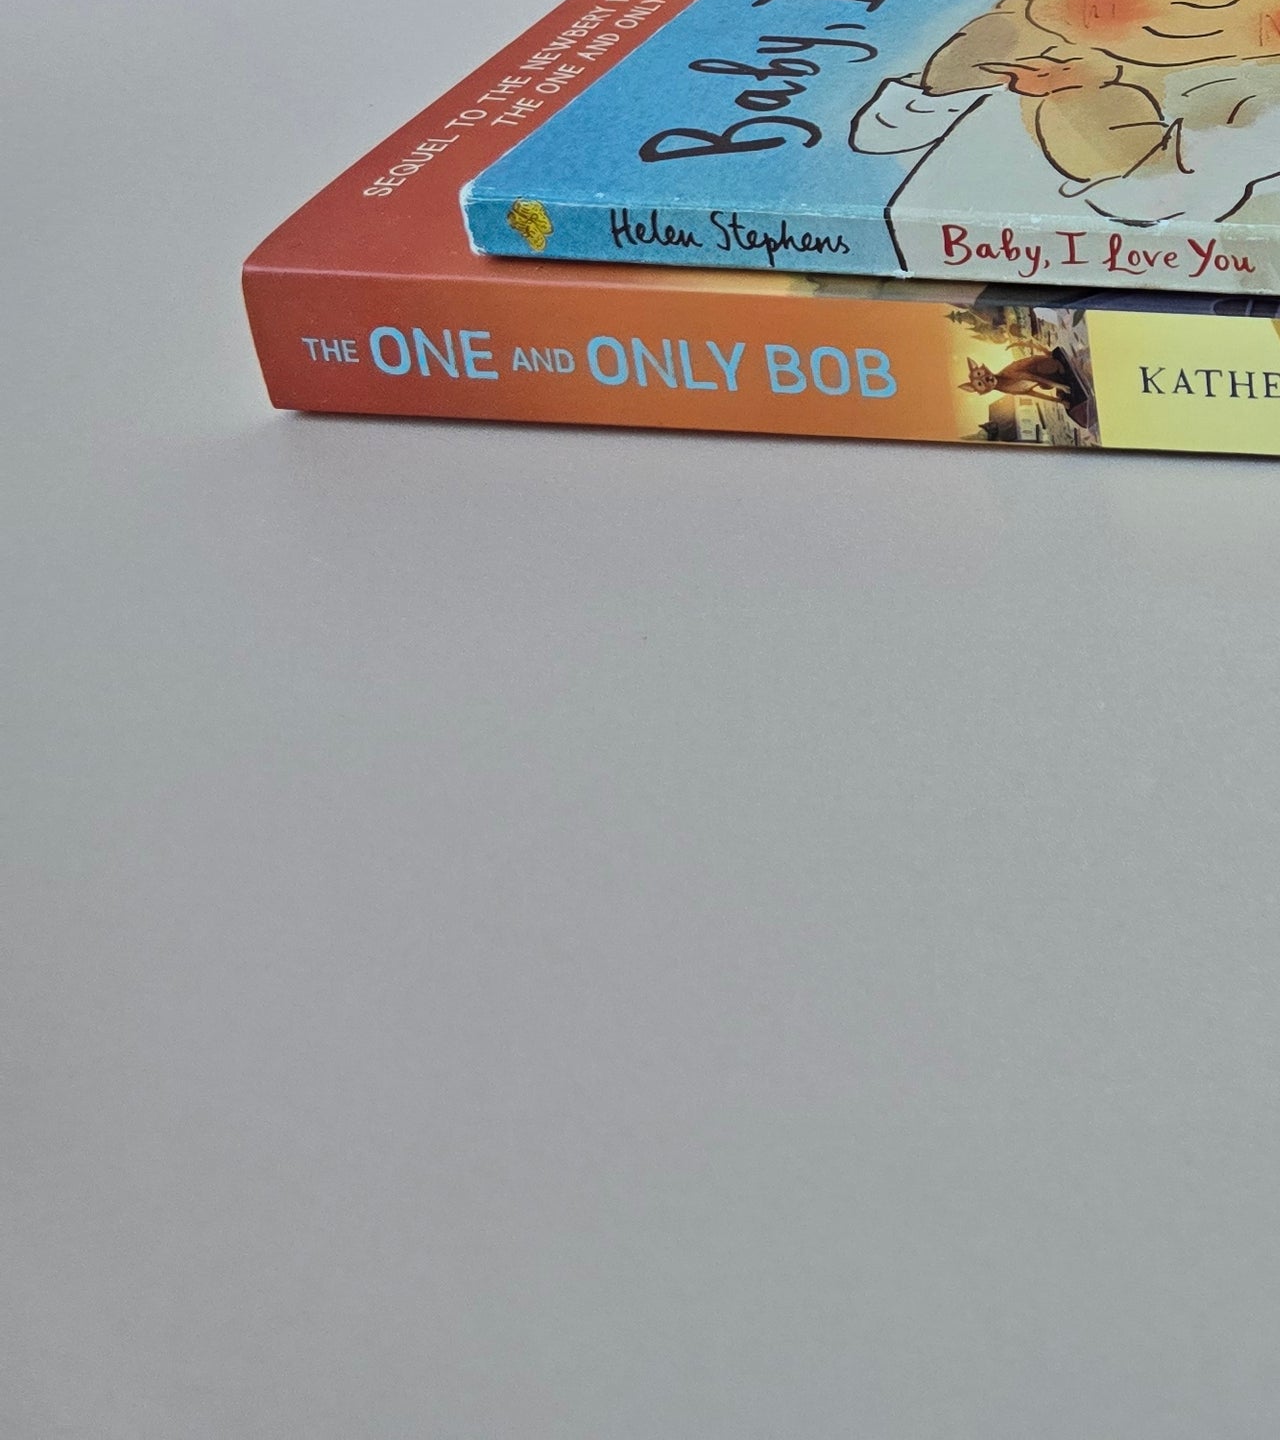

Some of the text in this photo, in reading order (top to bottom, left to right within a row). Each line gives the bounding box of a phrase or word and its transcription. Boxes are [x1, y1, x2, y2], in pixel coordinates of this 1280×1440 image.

[363, 133, 460, 198] SEQUEL
[445, 109, 488, 129] TO
[478, 76, 532, 103] THE
[520, 5, 617, 70] NEWBERY
[491, 98, 543, 126] THE
[536, 64, 586, 94] ONE
[578, 32, 621, 62] AND
[638, 23, 879, 163] Baby,
[610, 208, 851, 267] Helen Stephens
[942, 224, 1256, 278] Baby, I Love You
[301, 326, 898, 399] THE ONE AND ONLY BOB
